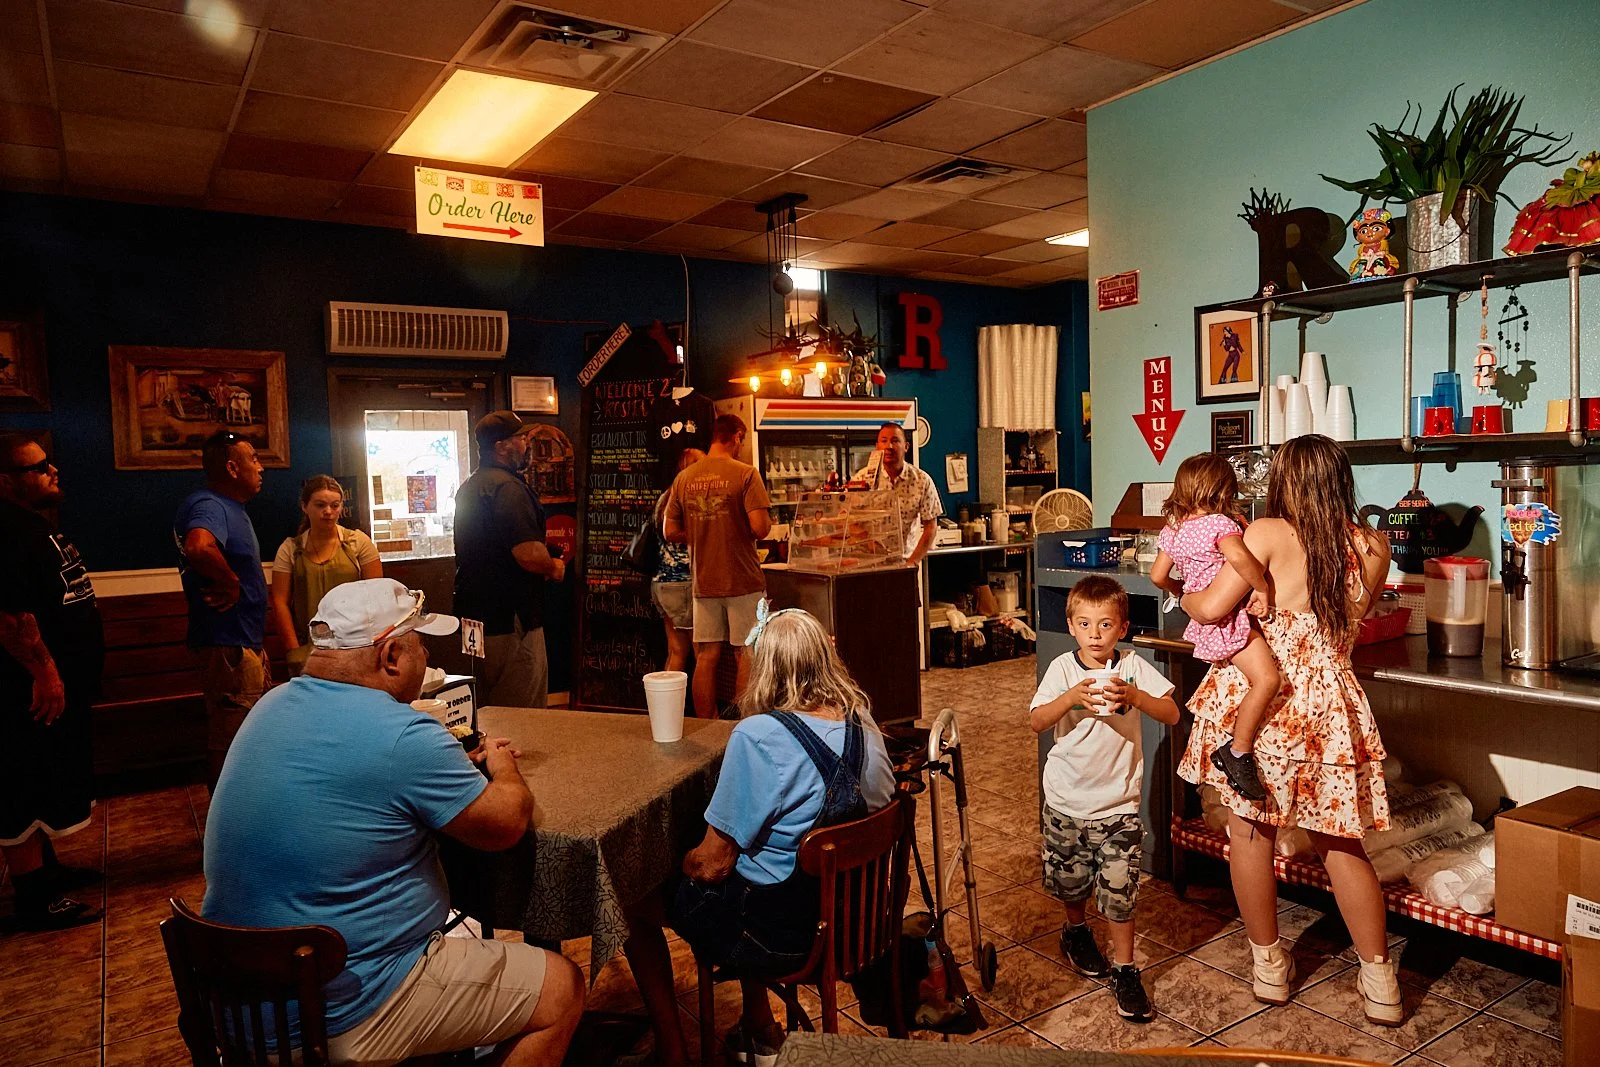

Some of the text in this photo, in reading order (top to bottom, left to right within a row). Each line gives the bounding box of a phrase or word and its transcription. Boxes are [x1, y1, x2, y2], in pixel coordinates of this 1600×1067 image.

[428, 193, 536, 225] Order Here
[897, 291, 949, 370] R
[582, 328, 628, 381] ORDER HERE
[1149, 360, 1167, 451] MENUS
[1388, 513, 1421, 525] COFFEE
[1525, 521, 1546, 532] tea
